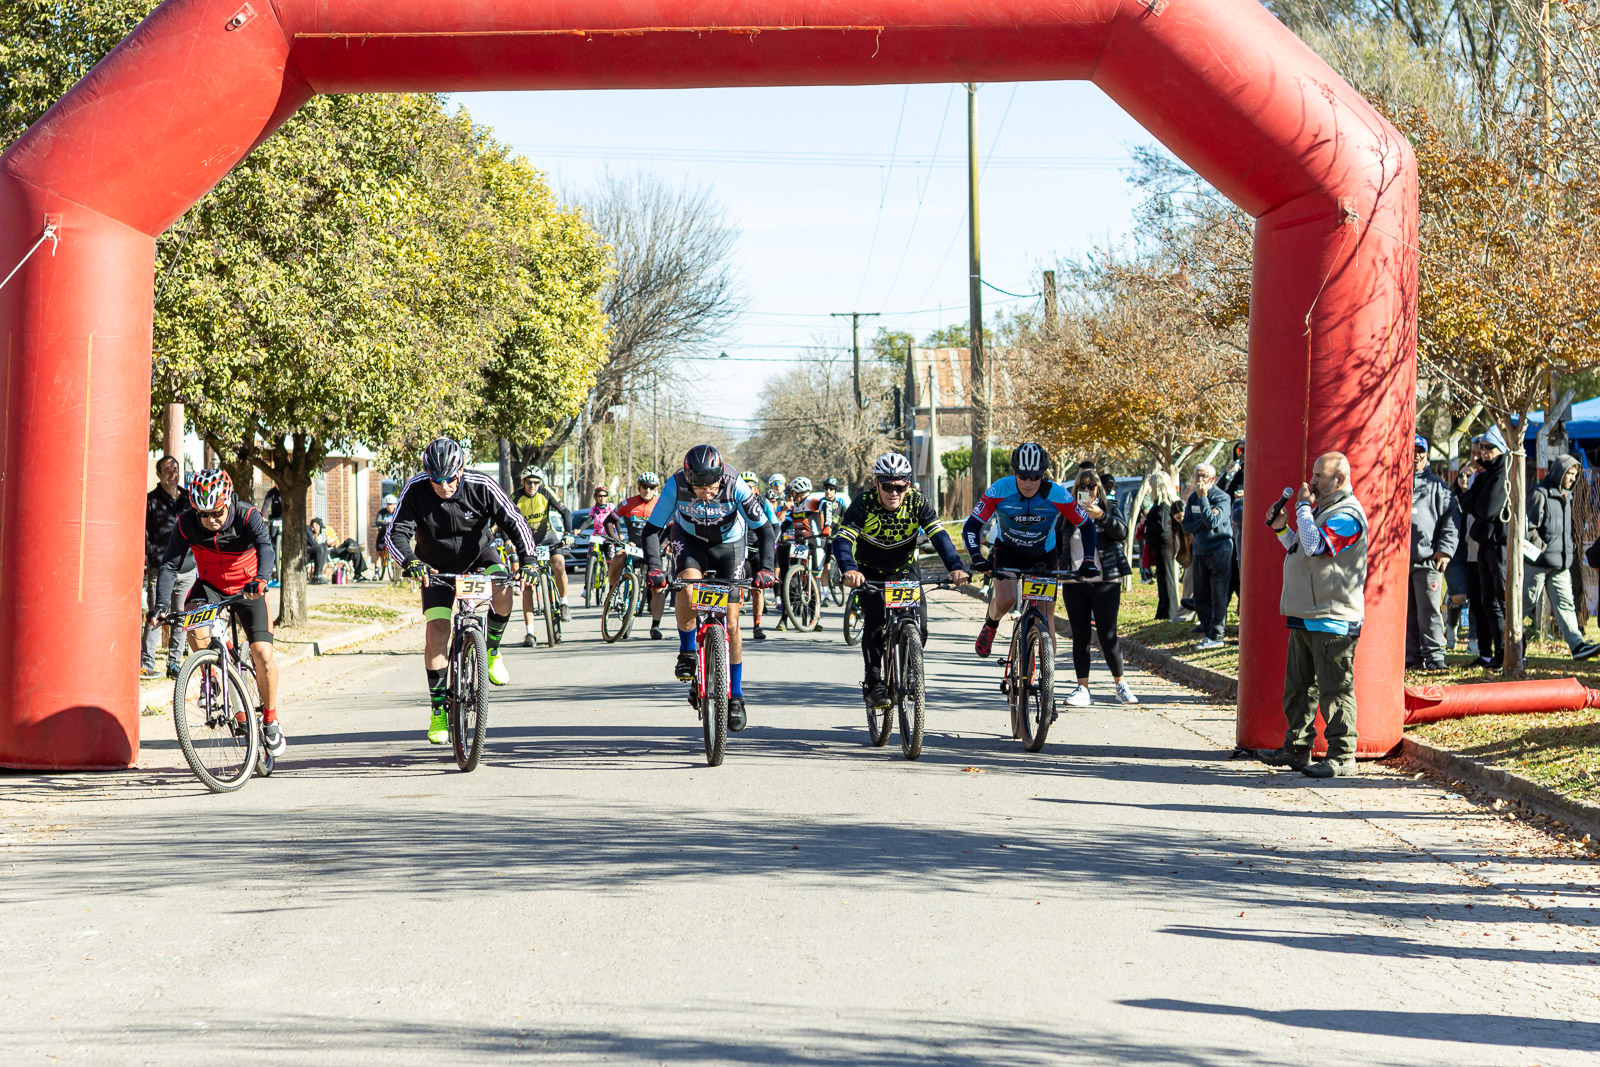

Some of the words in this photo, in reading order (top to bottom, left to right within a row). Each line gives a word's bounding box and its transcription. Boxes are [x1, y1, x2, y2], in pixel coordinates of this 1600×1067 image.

[462, 581, 486, 594] 35
[1029, 582, 1049, 596] 51
[696, 590, 725, 607] 167
[891, 588, 915, 602] 93
[187, 608, 214, 626] 160
